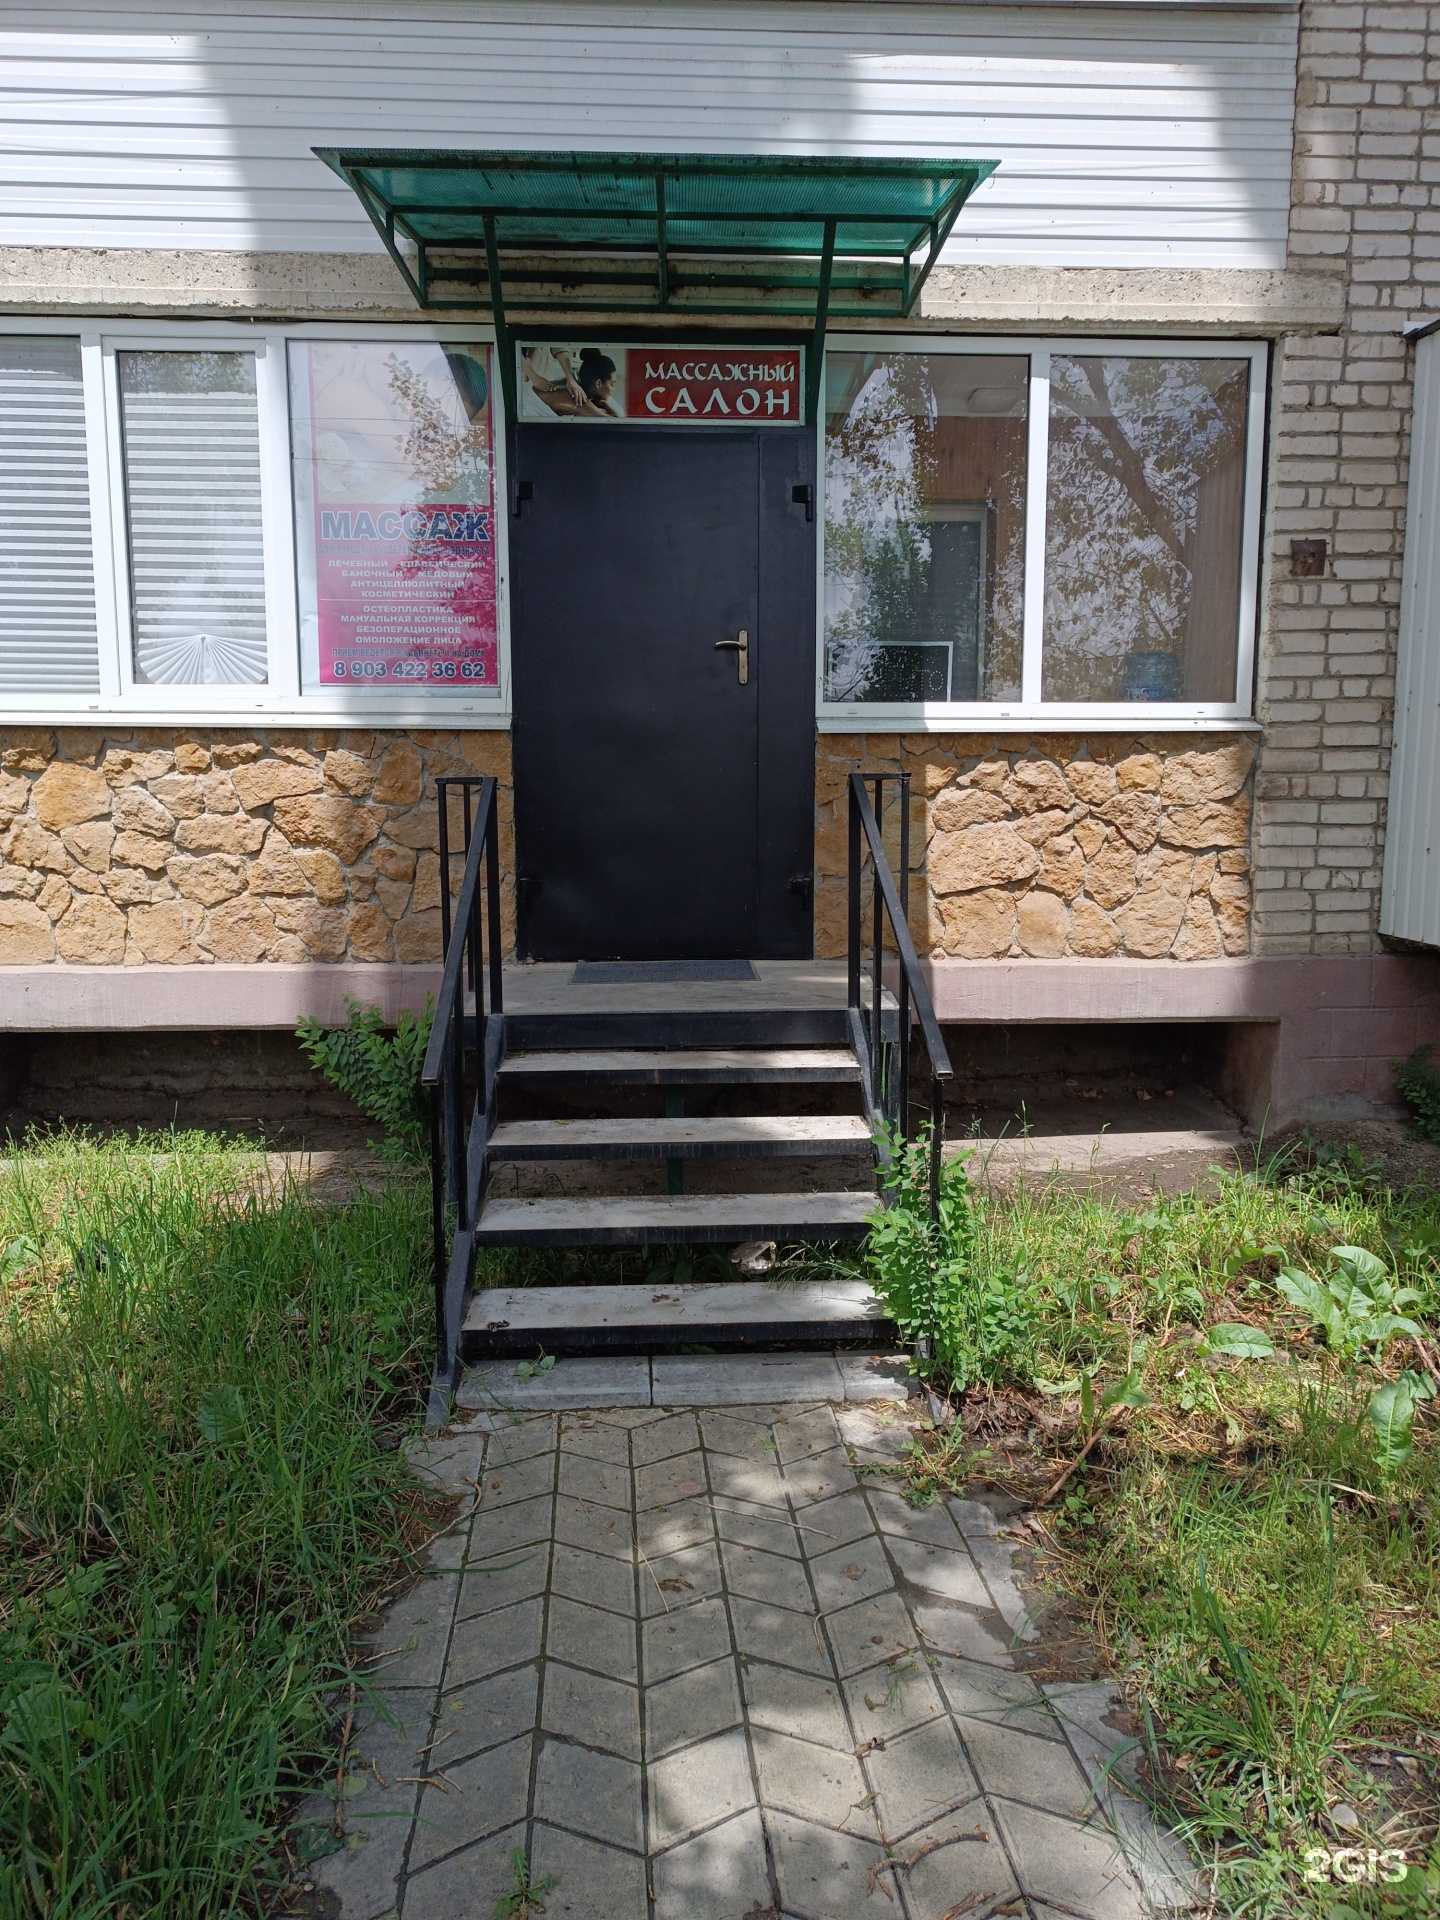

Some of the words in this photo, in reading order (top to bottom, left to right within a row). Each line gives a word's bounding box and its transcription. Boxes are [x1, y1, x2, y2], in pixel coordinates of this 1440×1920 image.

[645, 361, 794, 382] МАССАЖНЫЙ
[645, 387, 790, 415] САЛОН
[320, 511, 491, 541] МАССАЖ
[361, 590, 455, 598] КОСМЕТИЧЕСКИЙ
[363, 605, 454, 613] ОСТЕОПЛАСТИКА
[341, 615, 410, 623] МАНУАЛЬНАЯ
[414, 615, 477, 624] КОРРЕКЦИЯ
[356, 625, 462, 634] БЕЗОПЕРАЦИОННОЕ
[355, 635, 431, 644] ОМОЛОЖЕНИЕ
[433, 636, 462, 645] ЛИЦА
[334, 661, 347, 677] 8
[351, 661, 387, 677] 903
[392, 661, 427, 678] 422
[431, 662, 456, 678] 36
[461, 661, 486, 678] 62
